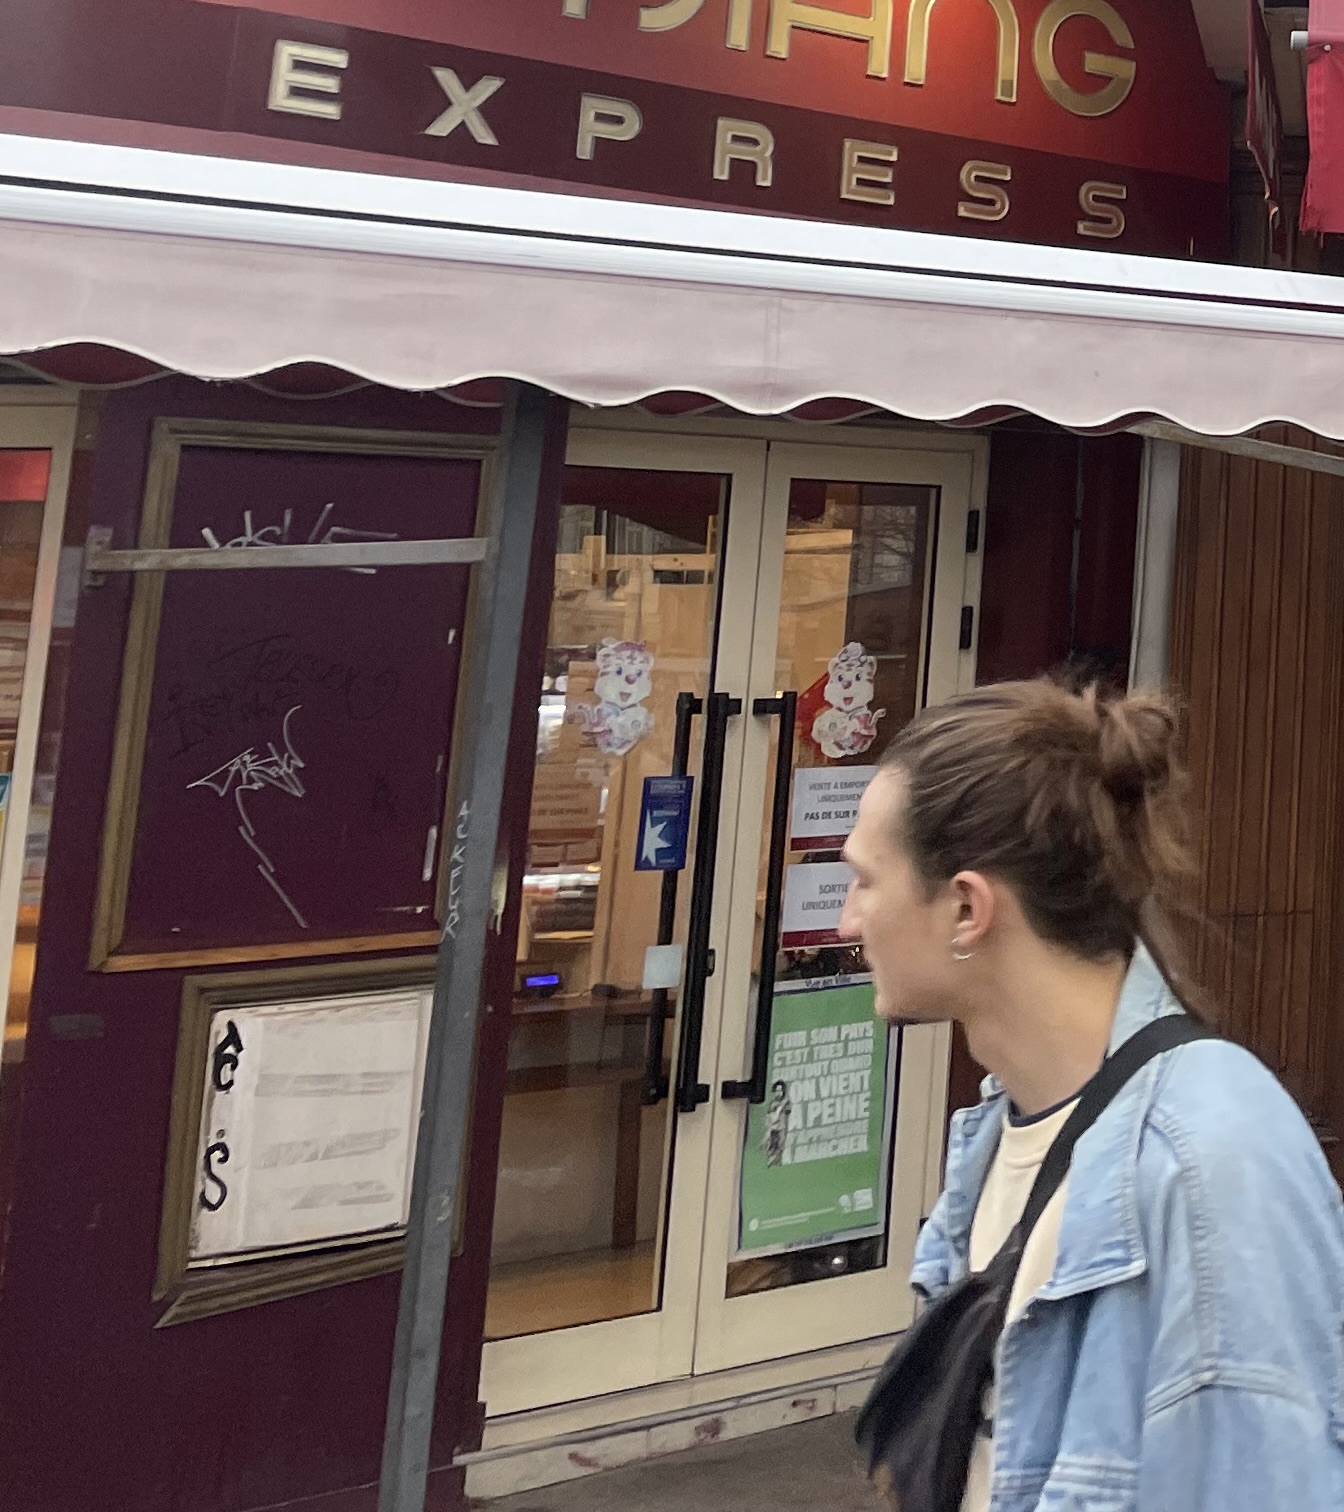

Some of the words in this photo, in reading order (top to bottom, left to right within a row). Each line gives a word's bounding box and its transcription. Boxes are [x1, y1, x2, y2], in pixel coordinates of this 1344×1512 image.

[265, 38, 1130, 240] EXPRESS
[804, 812, 820, 821] PAS
[821, 811, 832, 820] DE
[840, 1020, 874, 1041] PAYS
[819, 1069, 872, 1099] VIENT
[806, 1091, 871, 1128] PEINE
